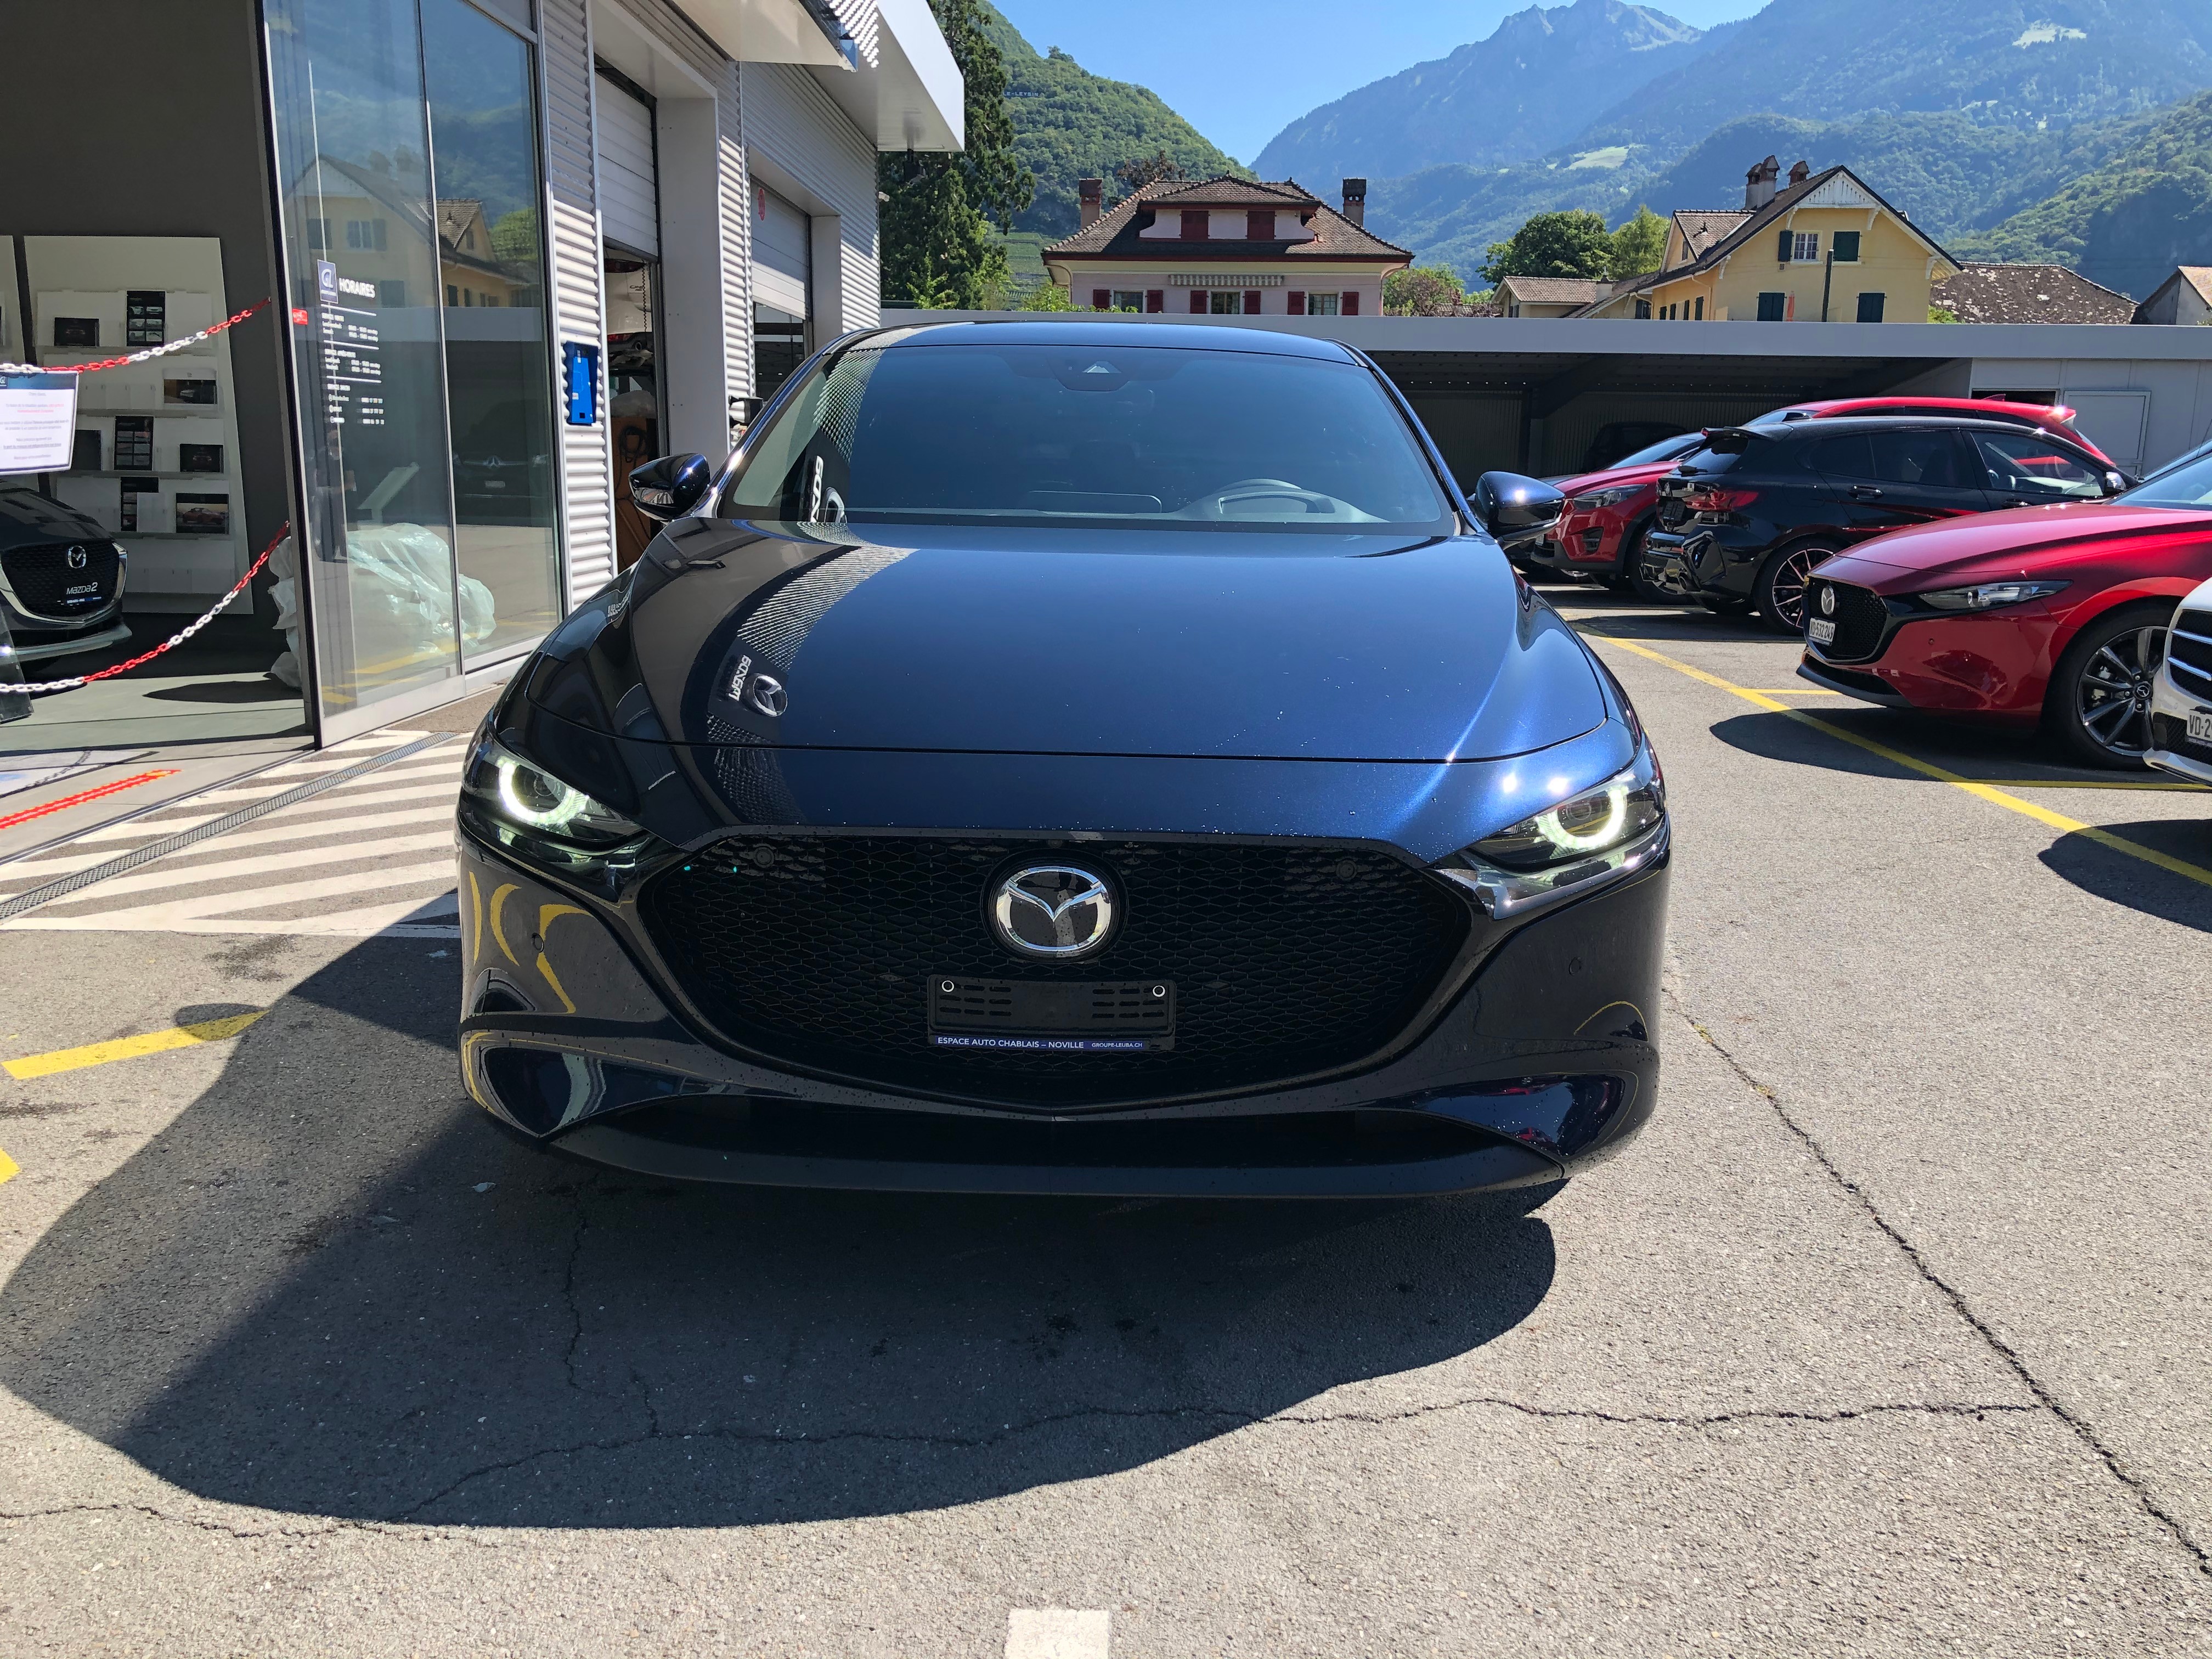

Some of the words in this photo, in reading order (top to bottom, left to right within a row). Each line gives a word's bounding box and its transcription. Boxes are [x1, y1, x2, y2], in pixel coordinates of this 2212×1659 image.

[339, 278, 375, 298] HORAIRES
[938, 1037, 969, 1045] ESPACE
[998, 1040, 1039, 1048] CHABLAIS
